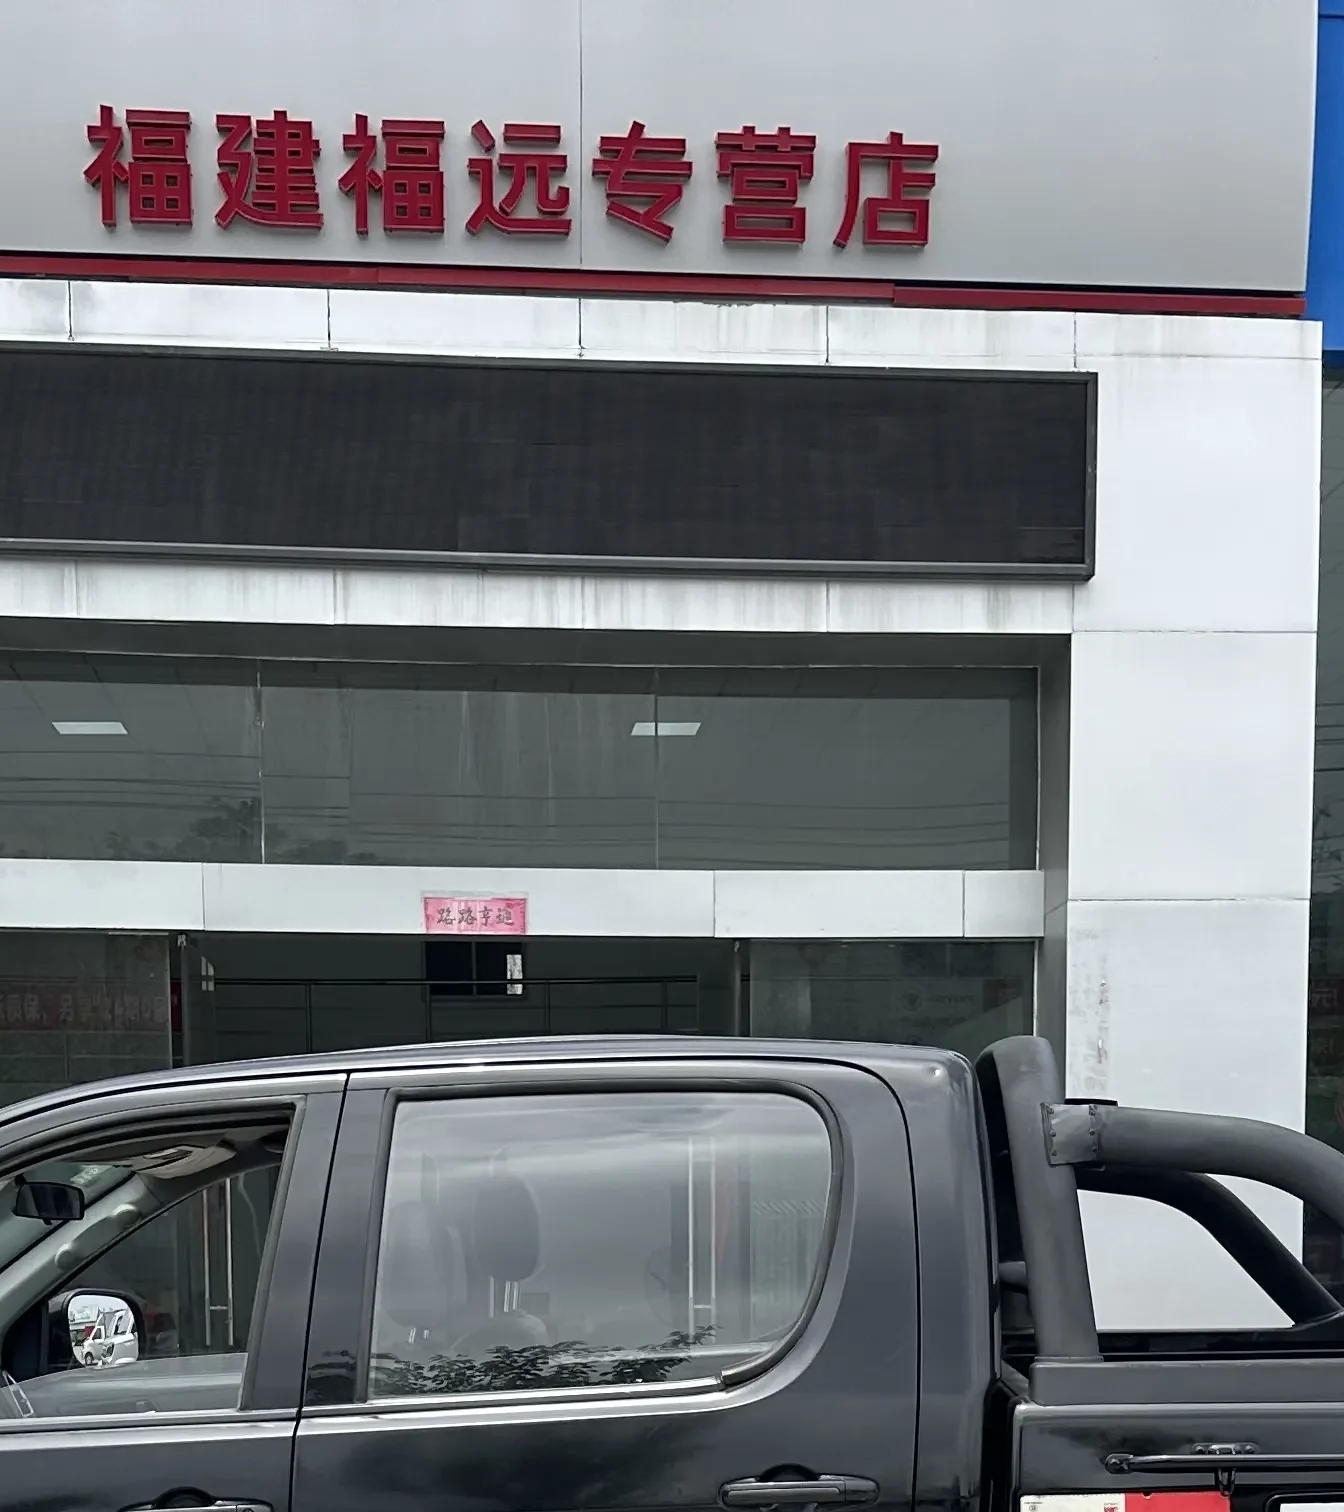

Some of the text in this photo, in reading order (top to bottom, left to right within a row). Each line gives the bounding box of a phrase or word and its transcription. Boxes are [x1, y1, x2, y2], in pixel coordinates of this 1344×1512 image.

[84, 104, 940, 249] 福建福远专营店
[436, 906, 515, 926] 路路亨通
